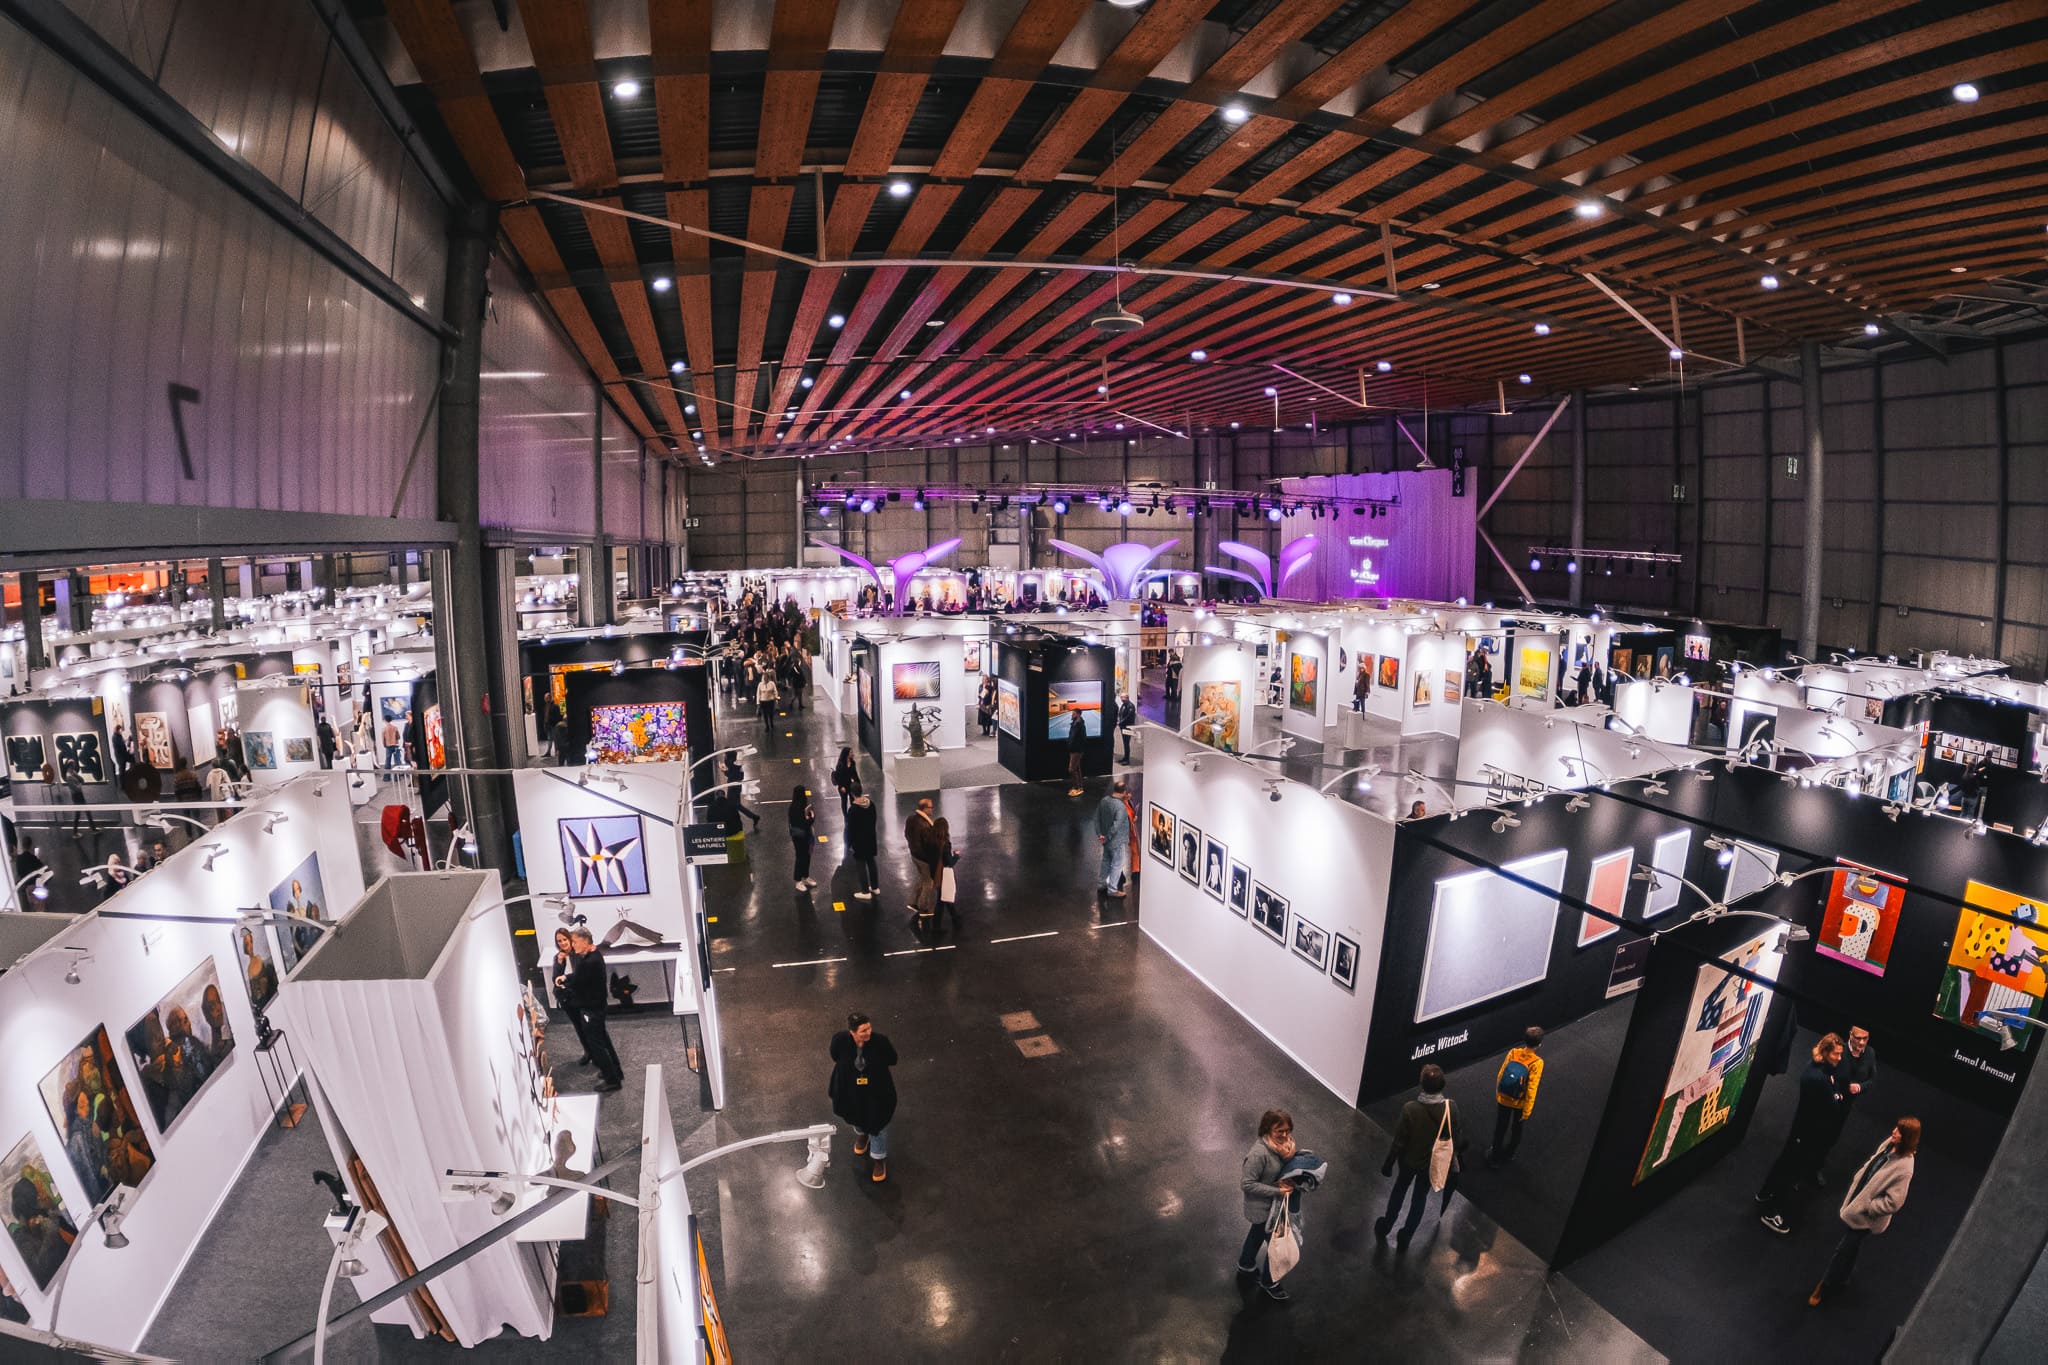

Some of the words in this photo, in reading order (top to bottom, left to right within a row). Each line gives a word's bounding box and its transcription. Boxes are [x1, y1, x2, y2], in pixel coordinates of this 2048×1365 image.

[1411, 1043, 1436, 1060] Jules
[1437, 1029, 1469, 1051] Wittock
[1979, 1060, 2016, 1083] Armand
